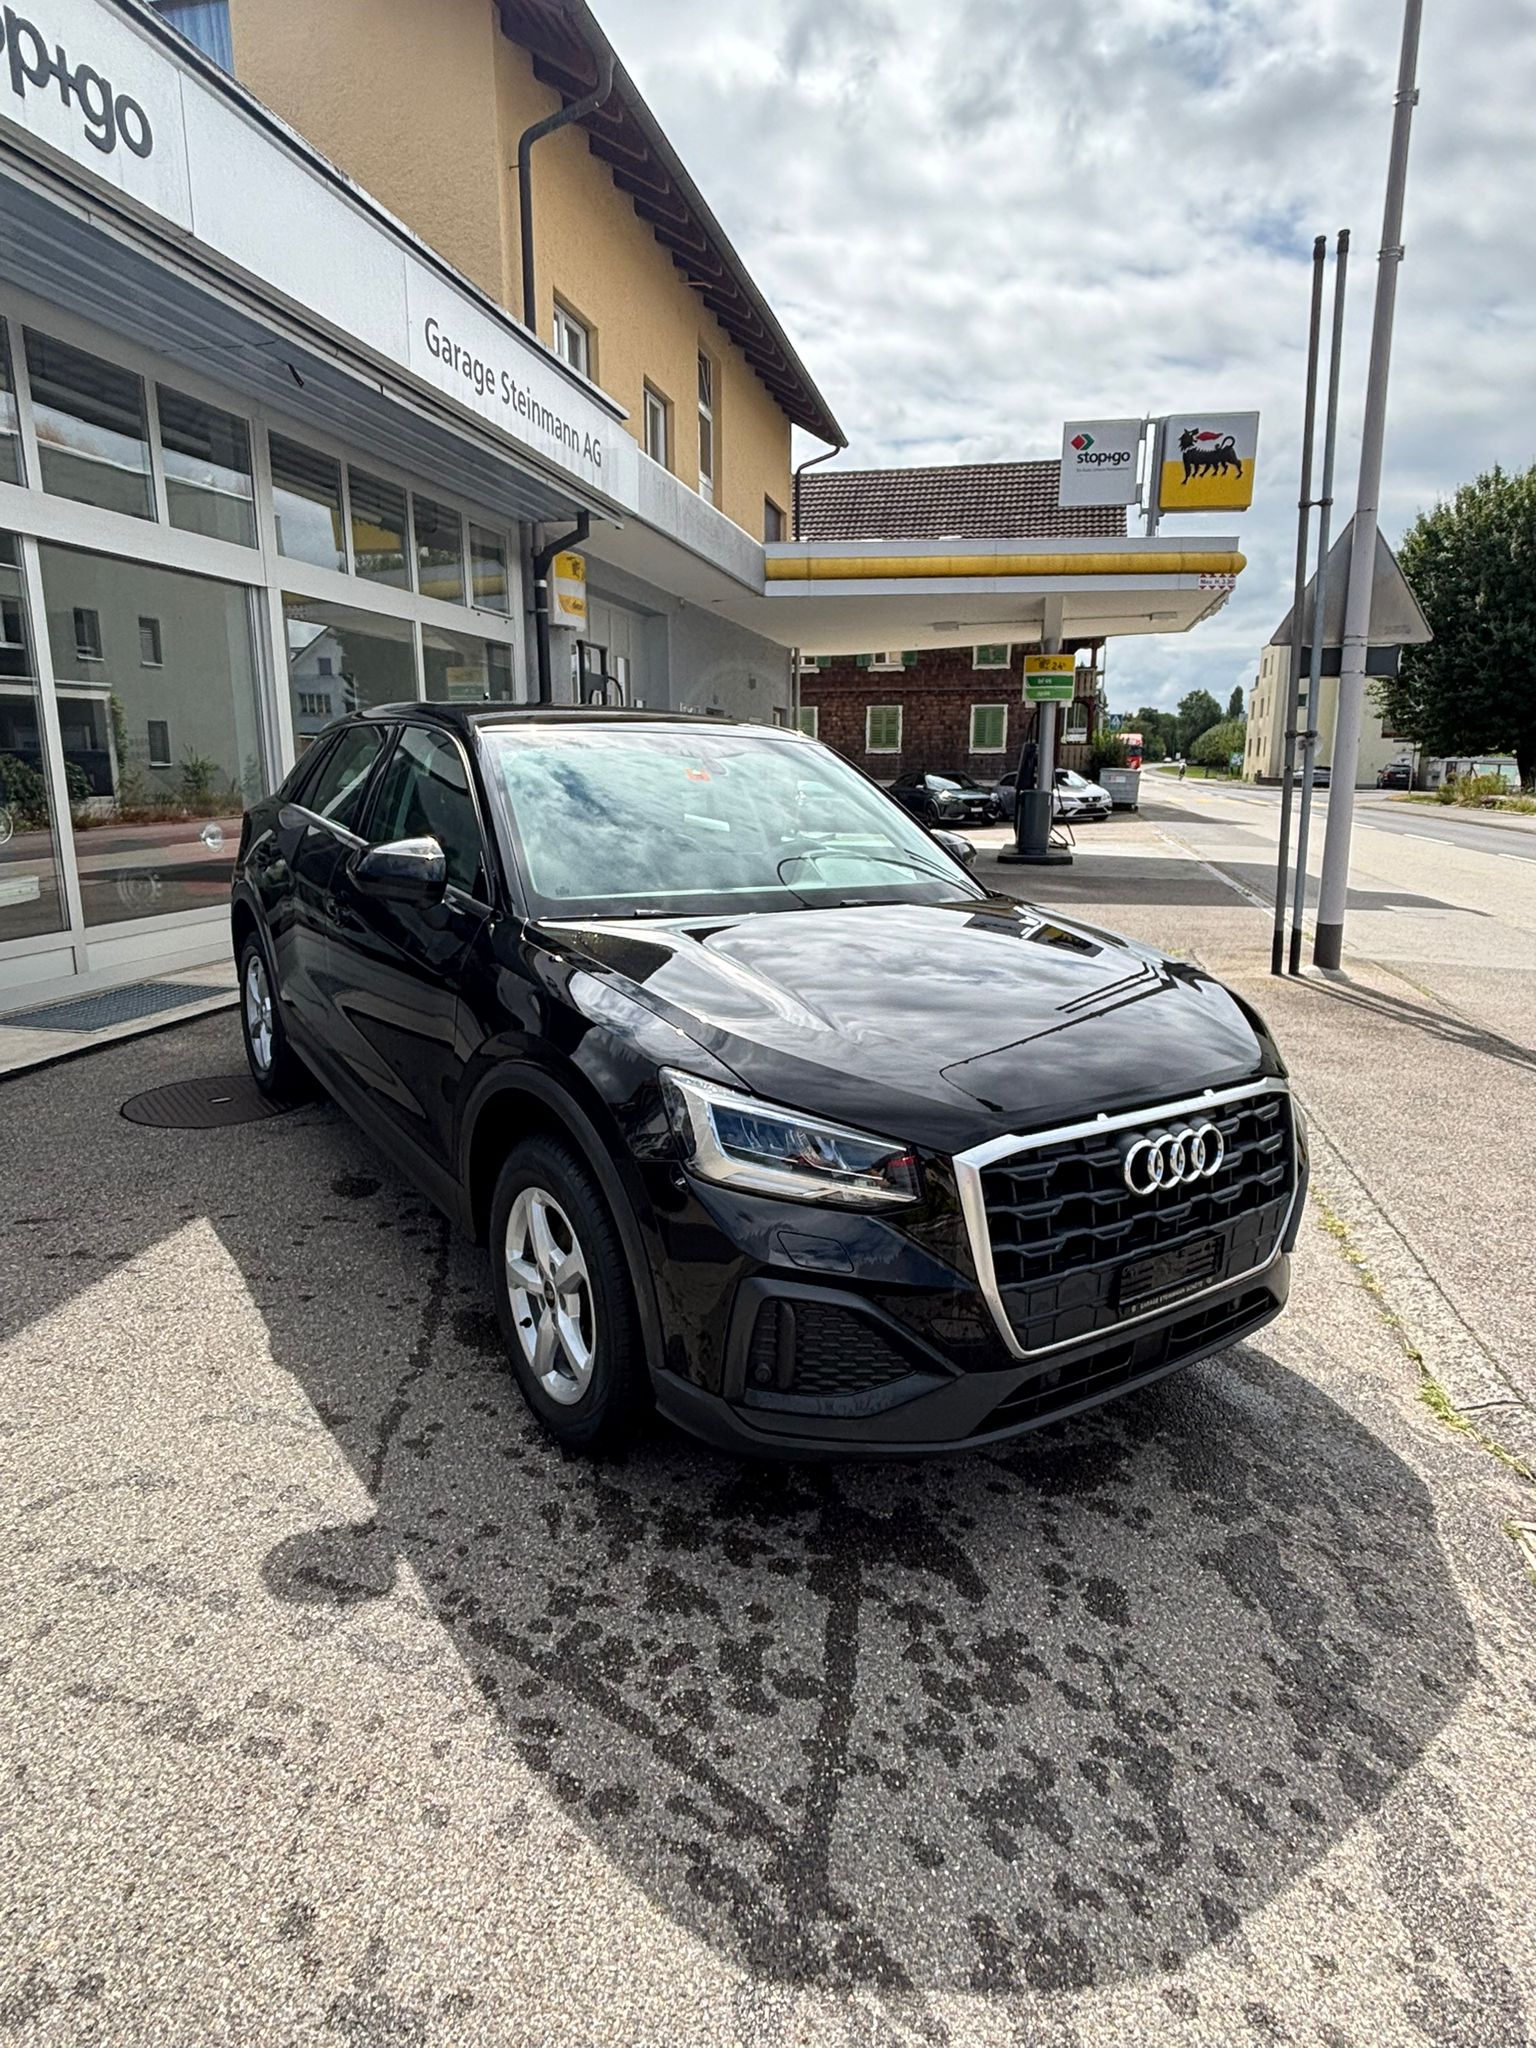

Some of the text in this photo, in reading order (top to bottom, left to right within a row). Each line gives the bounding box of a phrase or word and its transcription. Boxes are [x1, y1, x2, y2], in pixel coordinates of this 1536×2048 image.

[0, 5, 154, 159] p+go
[425, 317, 602, 467] Garage Steinmann AG
[1076, 451, 1131, 467] stop+go
